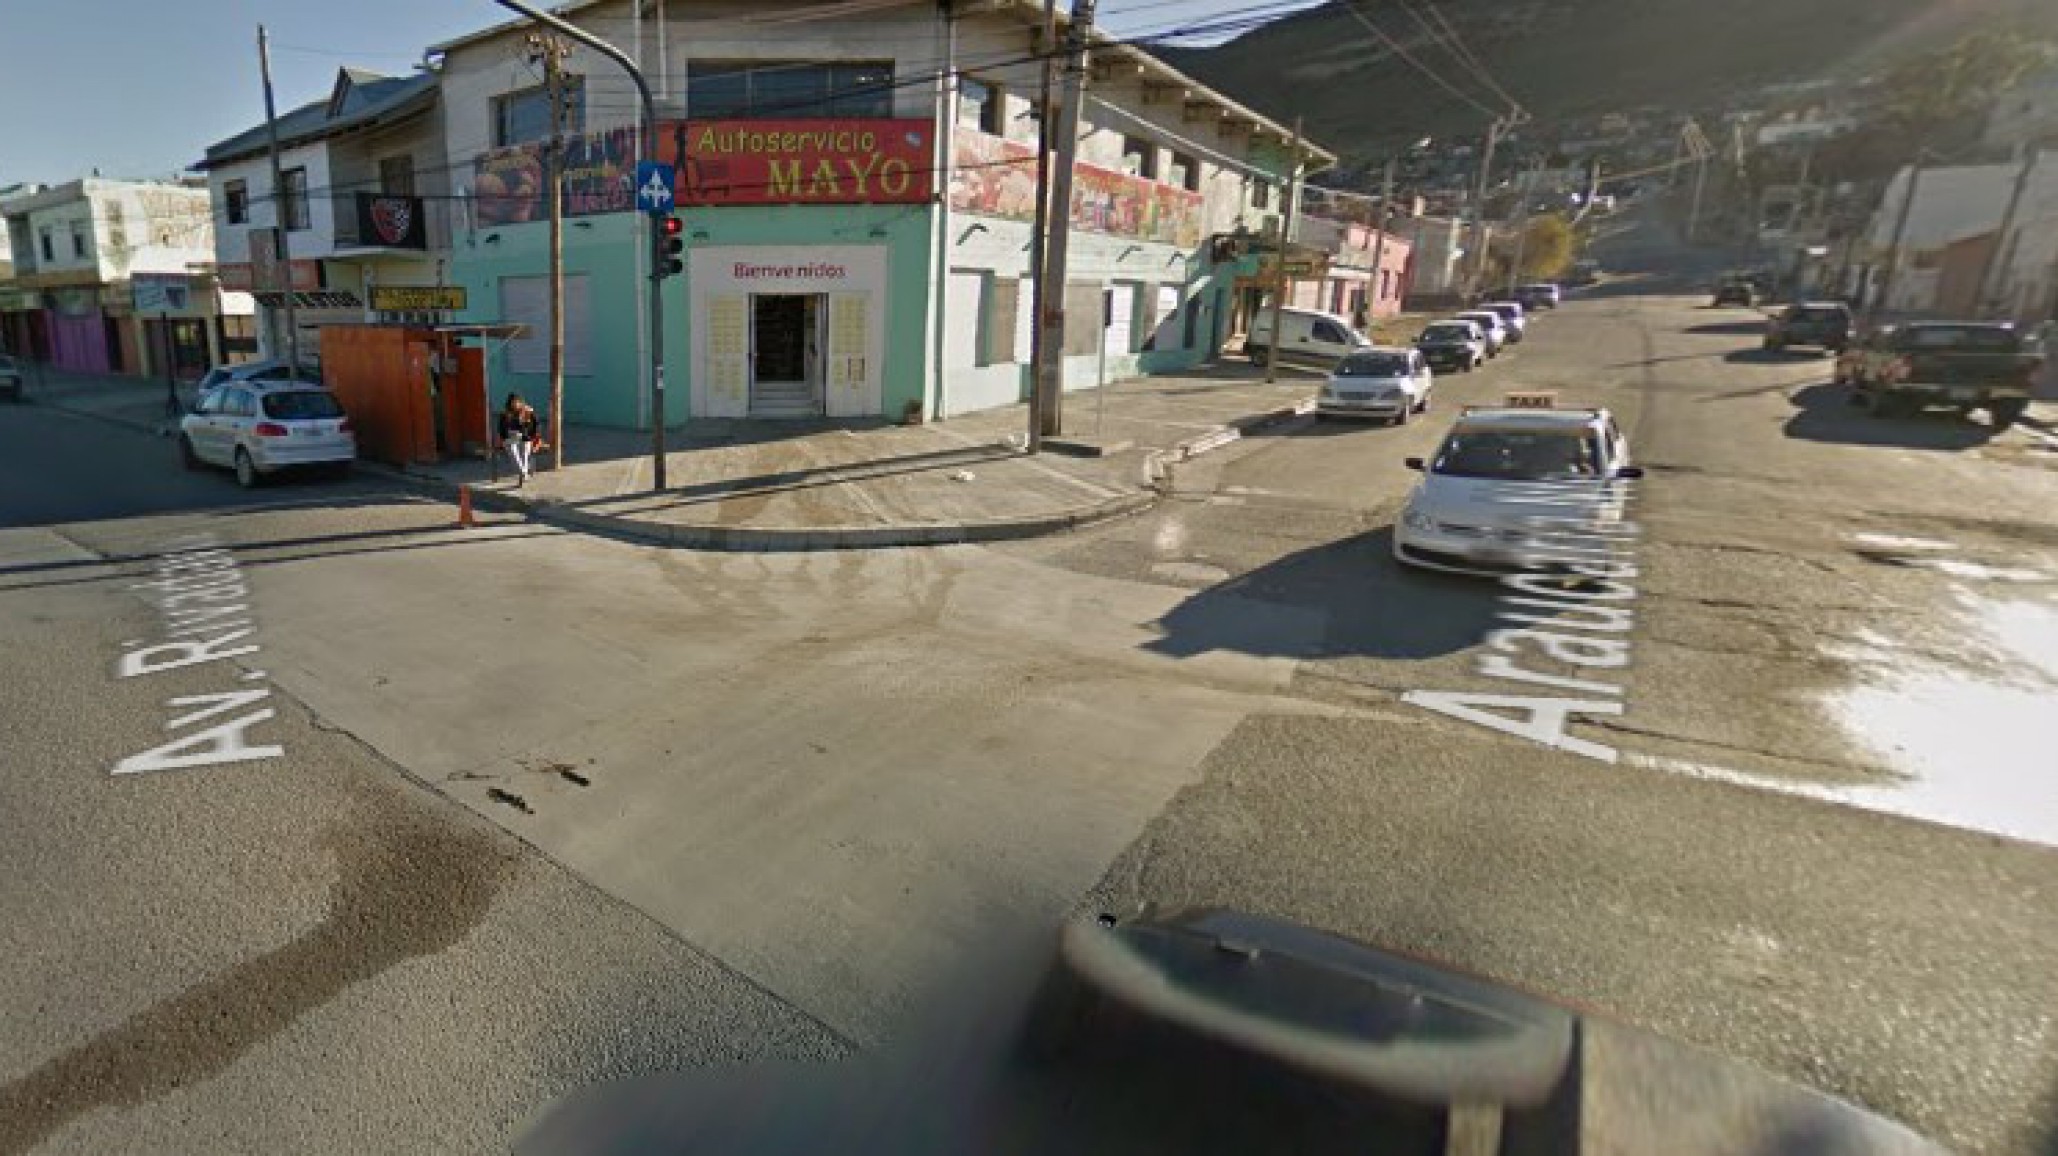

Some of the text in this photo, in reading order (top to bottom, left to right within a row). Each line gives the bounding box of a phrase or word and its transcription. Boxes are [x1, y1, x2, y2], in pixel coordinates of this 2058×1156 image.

[699, 126, 875, 153] Autoservicio
[768, 151, 910, 196] MAYO
[1509, 396, 1553, 408] TAXI
